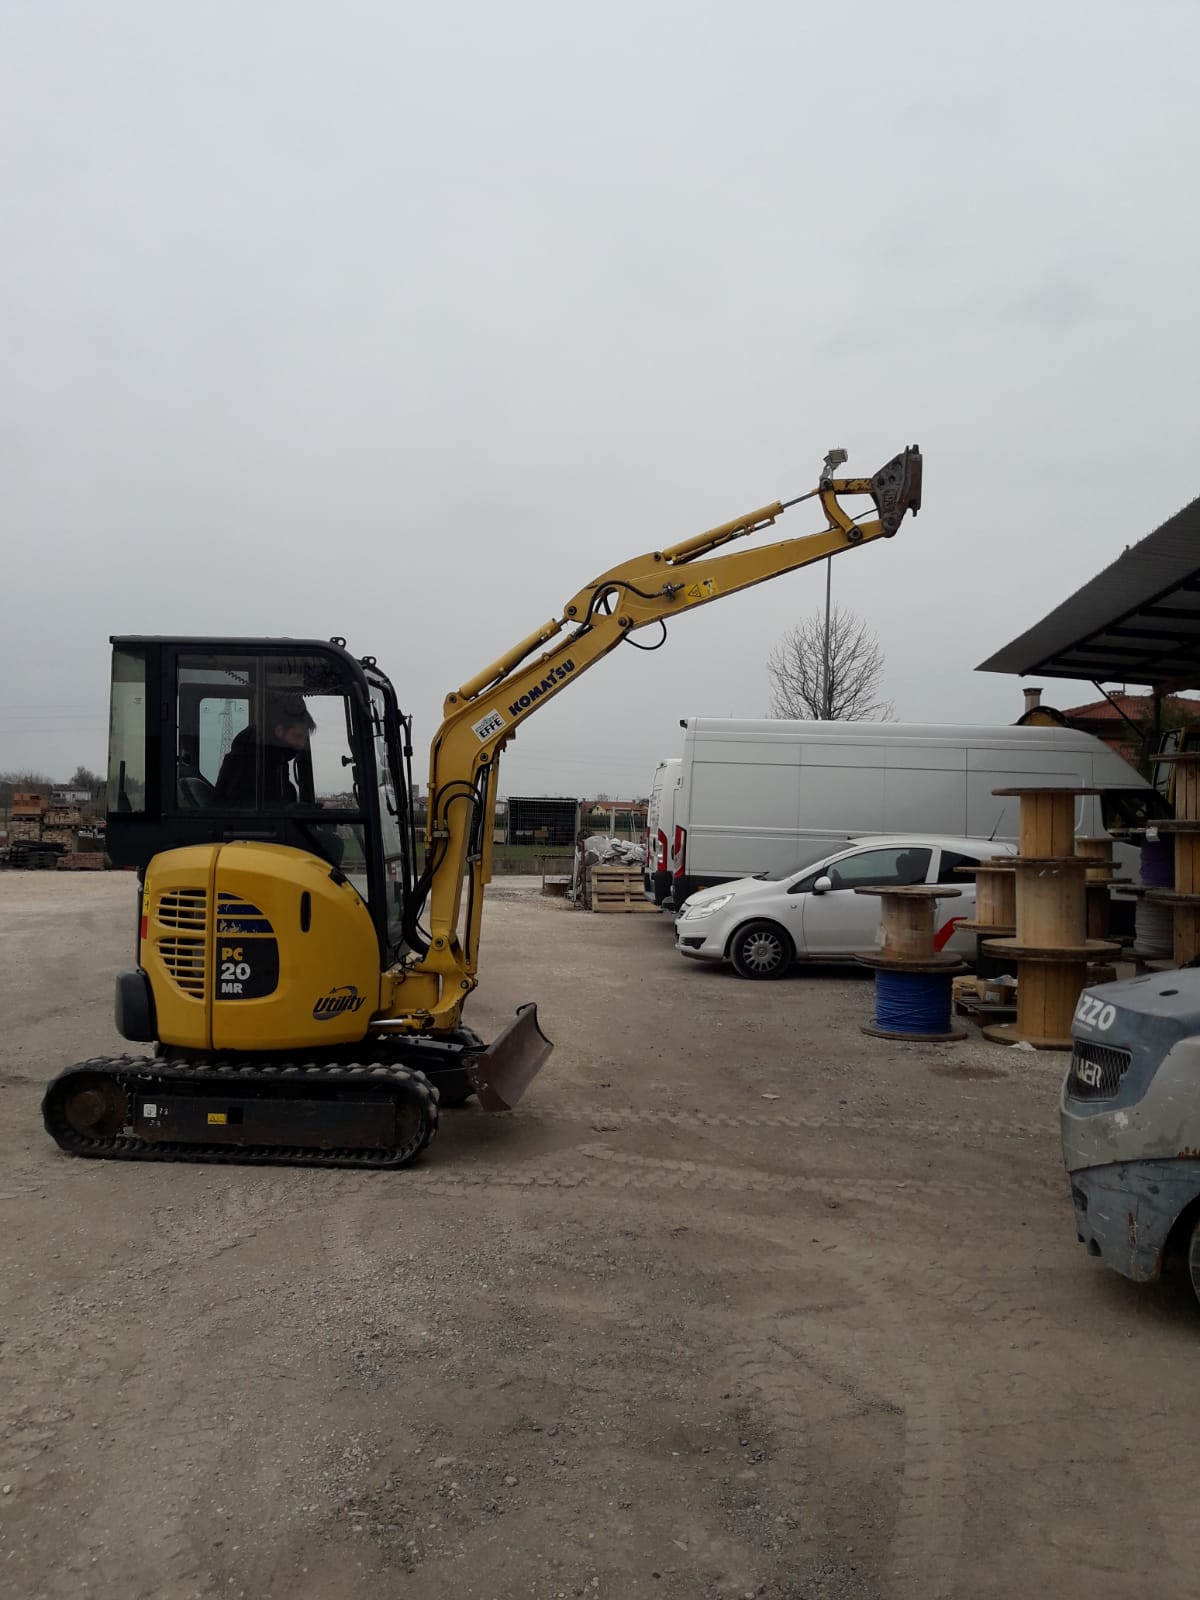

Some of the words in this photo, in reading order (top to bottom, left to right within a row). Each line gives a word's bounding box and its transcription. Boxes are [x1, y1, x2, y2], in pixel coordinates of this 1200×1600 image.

[508, 658, 576, 717] KOMATSU
[479, 717, 503, 738] EFFE
[222, 947, 243, 961] PC
[221, 962, 251, 980] 20
[221, 982, 243, 994] MR
[313, 992, 367, 1012] Utility
